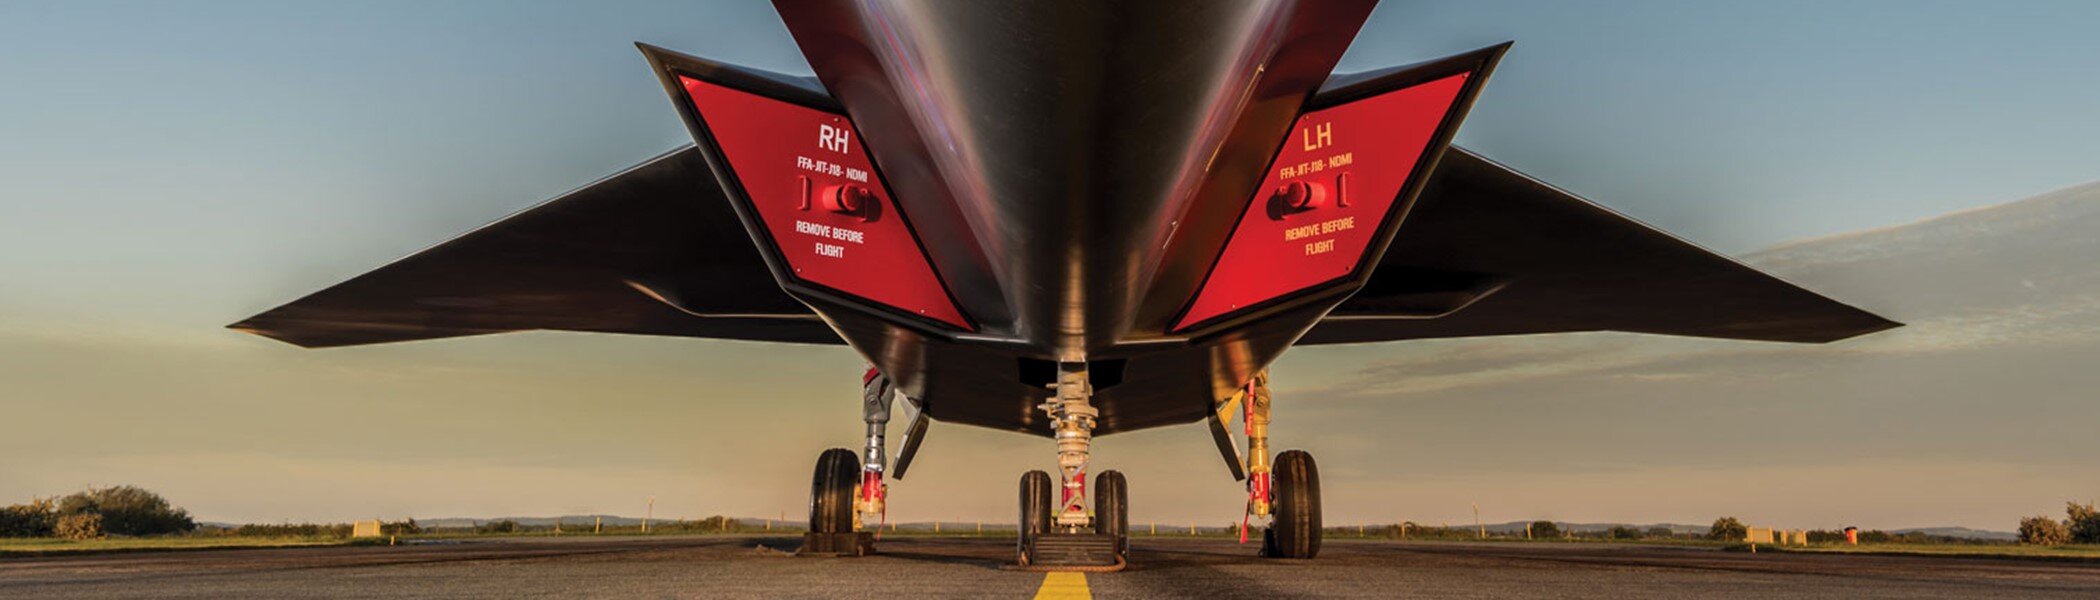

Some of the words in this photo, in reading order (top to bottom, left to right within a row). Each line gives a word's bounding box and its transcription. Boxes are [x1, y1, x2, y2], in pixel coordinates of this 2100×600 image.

[819, 124, 849, 154] RH
[1304, 123, 1332, 151] LH
[796, 220, 830, 238] REMOVE
[833, 227, 864, 243] BEFORE
[1285, 223, 1320, 241] REMOVE
[1322, 217, 1354, 234] BEFORE
[815, 242, 844, 258] FLIGHT
[1305, 239, 1334, 256] FLIGHT
